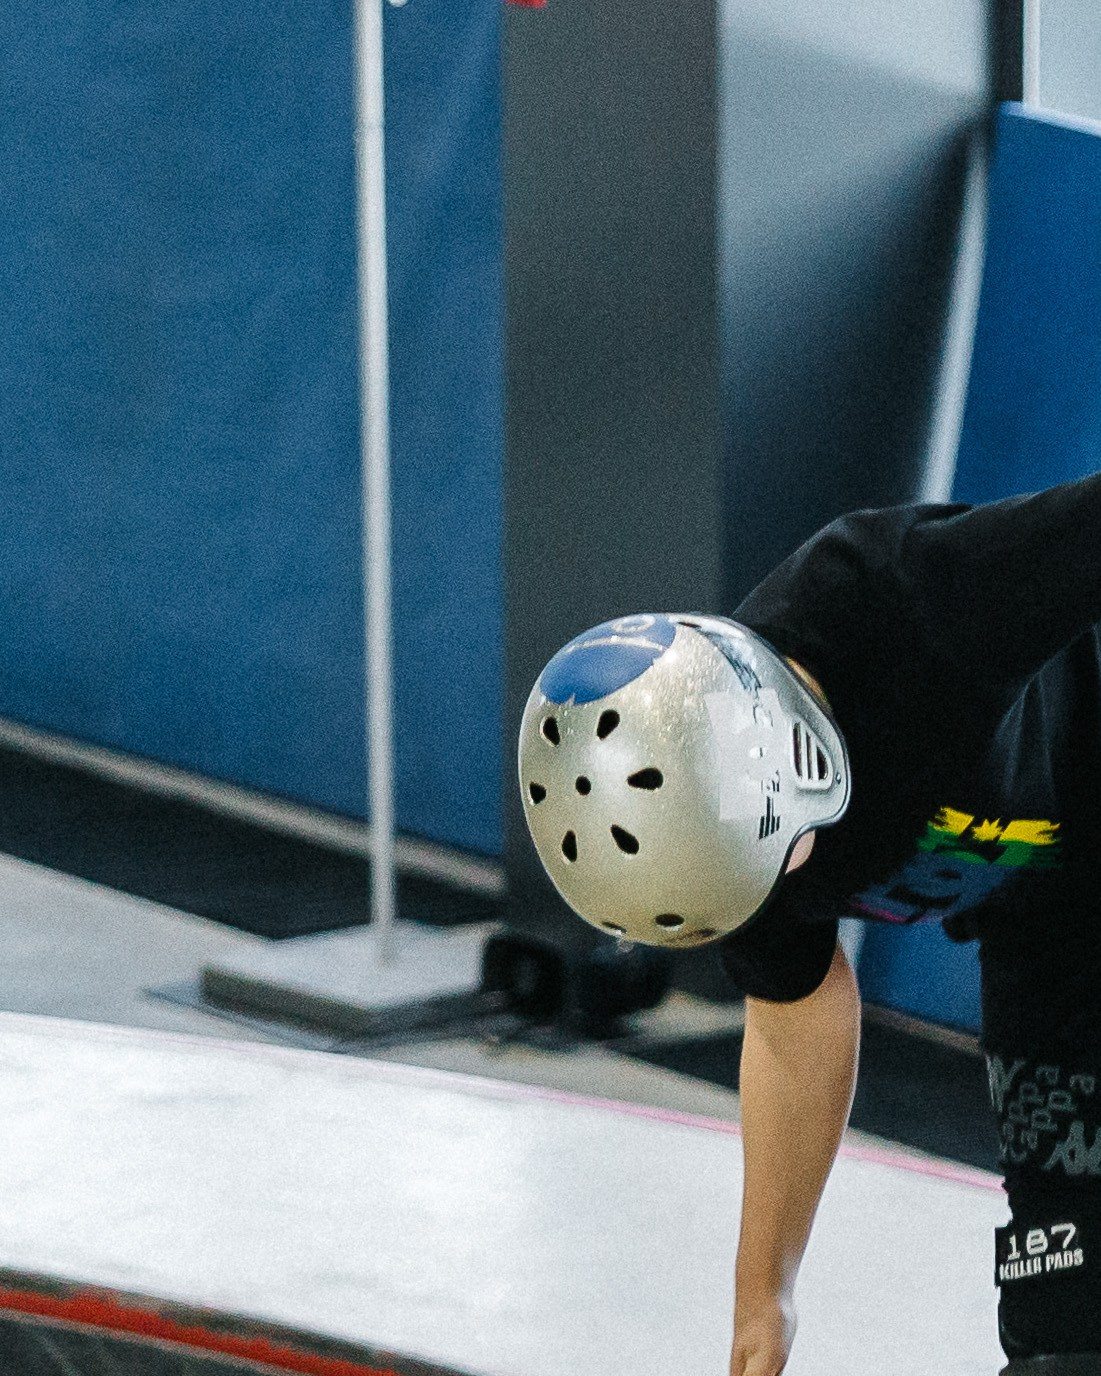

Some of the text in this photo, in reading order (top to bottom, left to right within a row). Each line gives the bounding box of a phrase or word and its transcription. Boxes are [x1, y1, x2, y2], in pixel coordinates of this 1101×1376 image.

[1007, 1222, 1076, 1261] 187
[999, 1248, 1084, 1280] KILLER PADS
